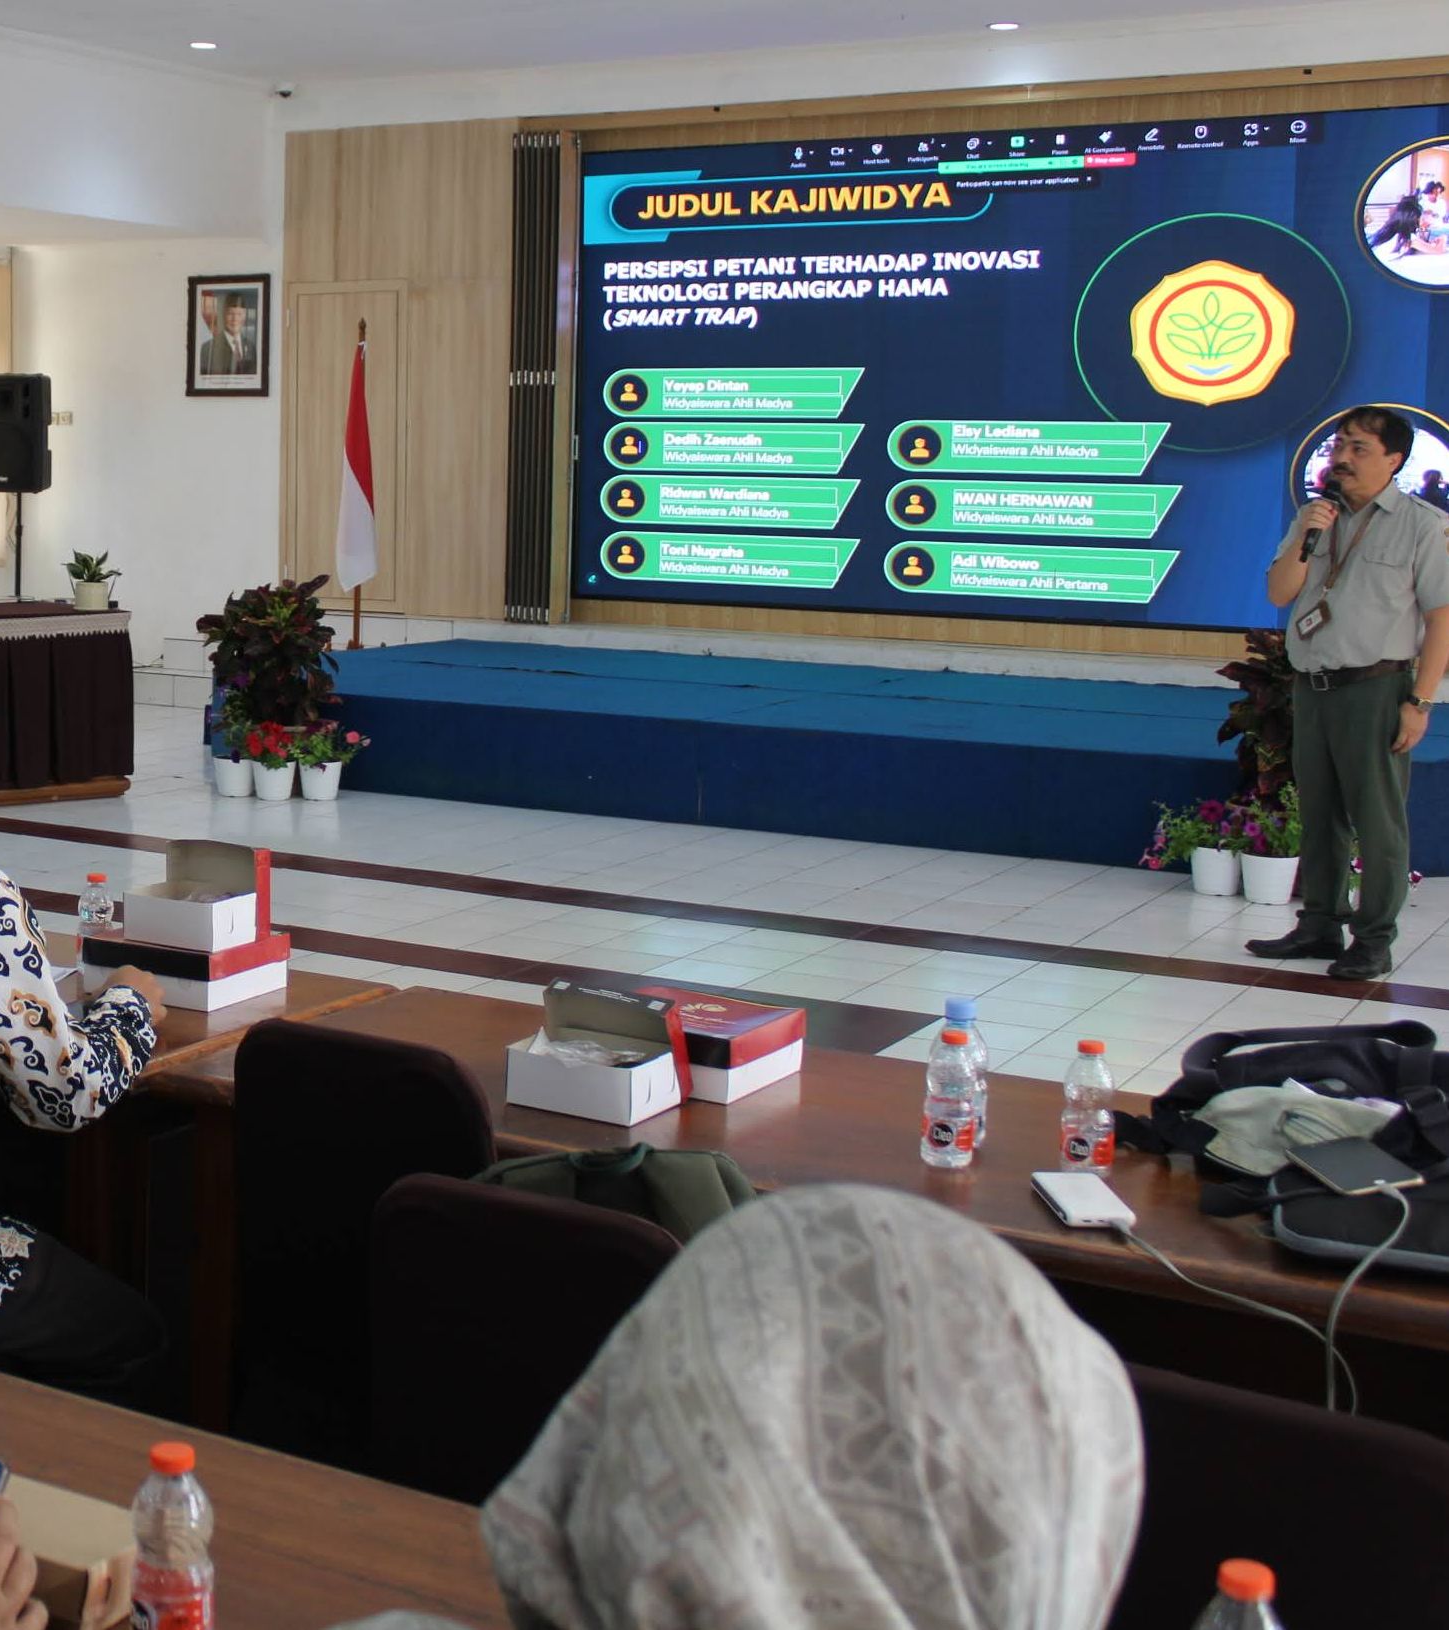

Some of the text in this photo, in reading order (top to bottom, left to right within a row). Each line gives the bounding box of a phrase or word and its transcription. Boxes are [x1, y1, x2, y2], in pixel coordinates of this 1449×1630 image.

[956, 180, 990, 188] Participants
[992, 179, 1003, 187] can
[1030, 177, 1043, 186] your
[1045, 177, 1079, 185] application
[638, 182, 951, 219] JUDUL KAJIWIDYA
[603, 250, 1040, 281] PERSEPSI PETANI TERHADAP INOVASI
[603, 278, 948, 303] TEKNOLOGI PERANGKAP HAMA
[603, 307, 758, 329] (SMART TRAP)
[707, 380, 749, 391] Dintan
[665, 397, 793, 410] Widyaiswara Ahli Madya
[985, 425, 1040, 438] Lediana
[665, 451, 793, 465] Widyaiswara Ahli Madya
[952, 443, 1098, 458] Widyaiswara Ahli Madya
[661, 486, 770, 501] Ridwan Wardiana
[955, 492, 1093, 509] IWAN HERNAWAN
[661, 504, 789, 520] Widyaiswara Ahli Madya
[954, 511, 1094, 526] Widyaiswara Ahli Muda
[662, 544, 744, 559] Toni Nugraha
[661, 561, 789, 578] Widyaiswara Ahli Madya
[952, 555, 1040, 570] Adi Wibowo
[952, 573, 1109, 591] Widyaiswara Ahli Pertama
